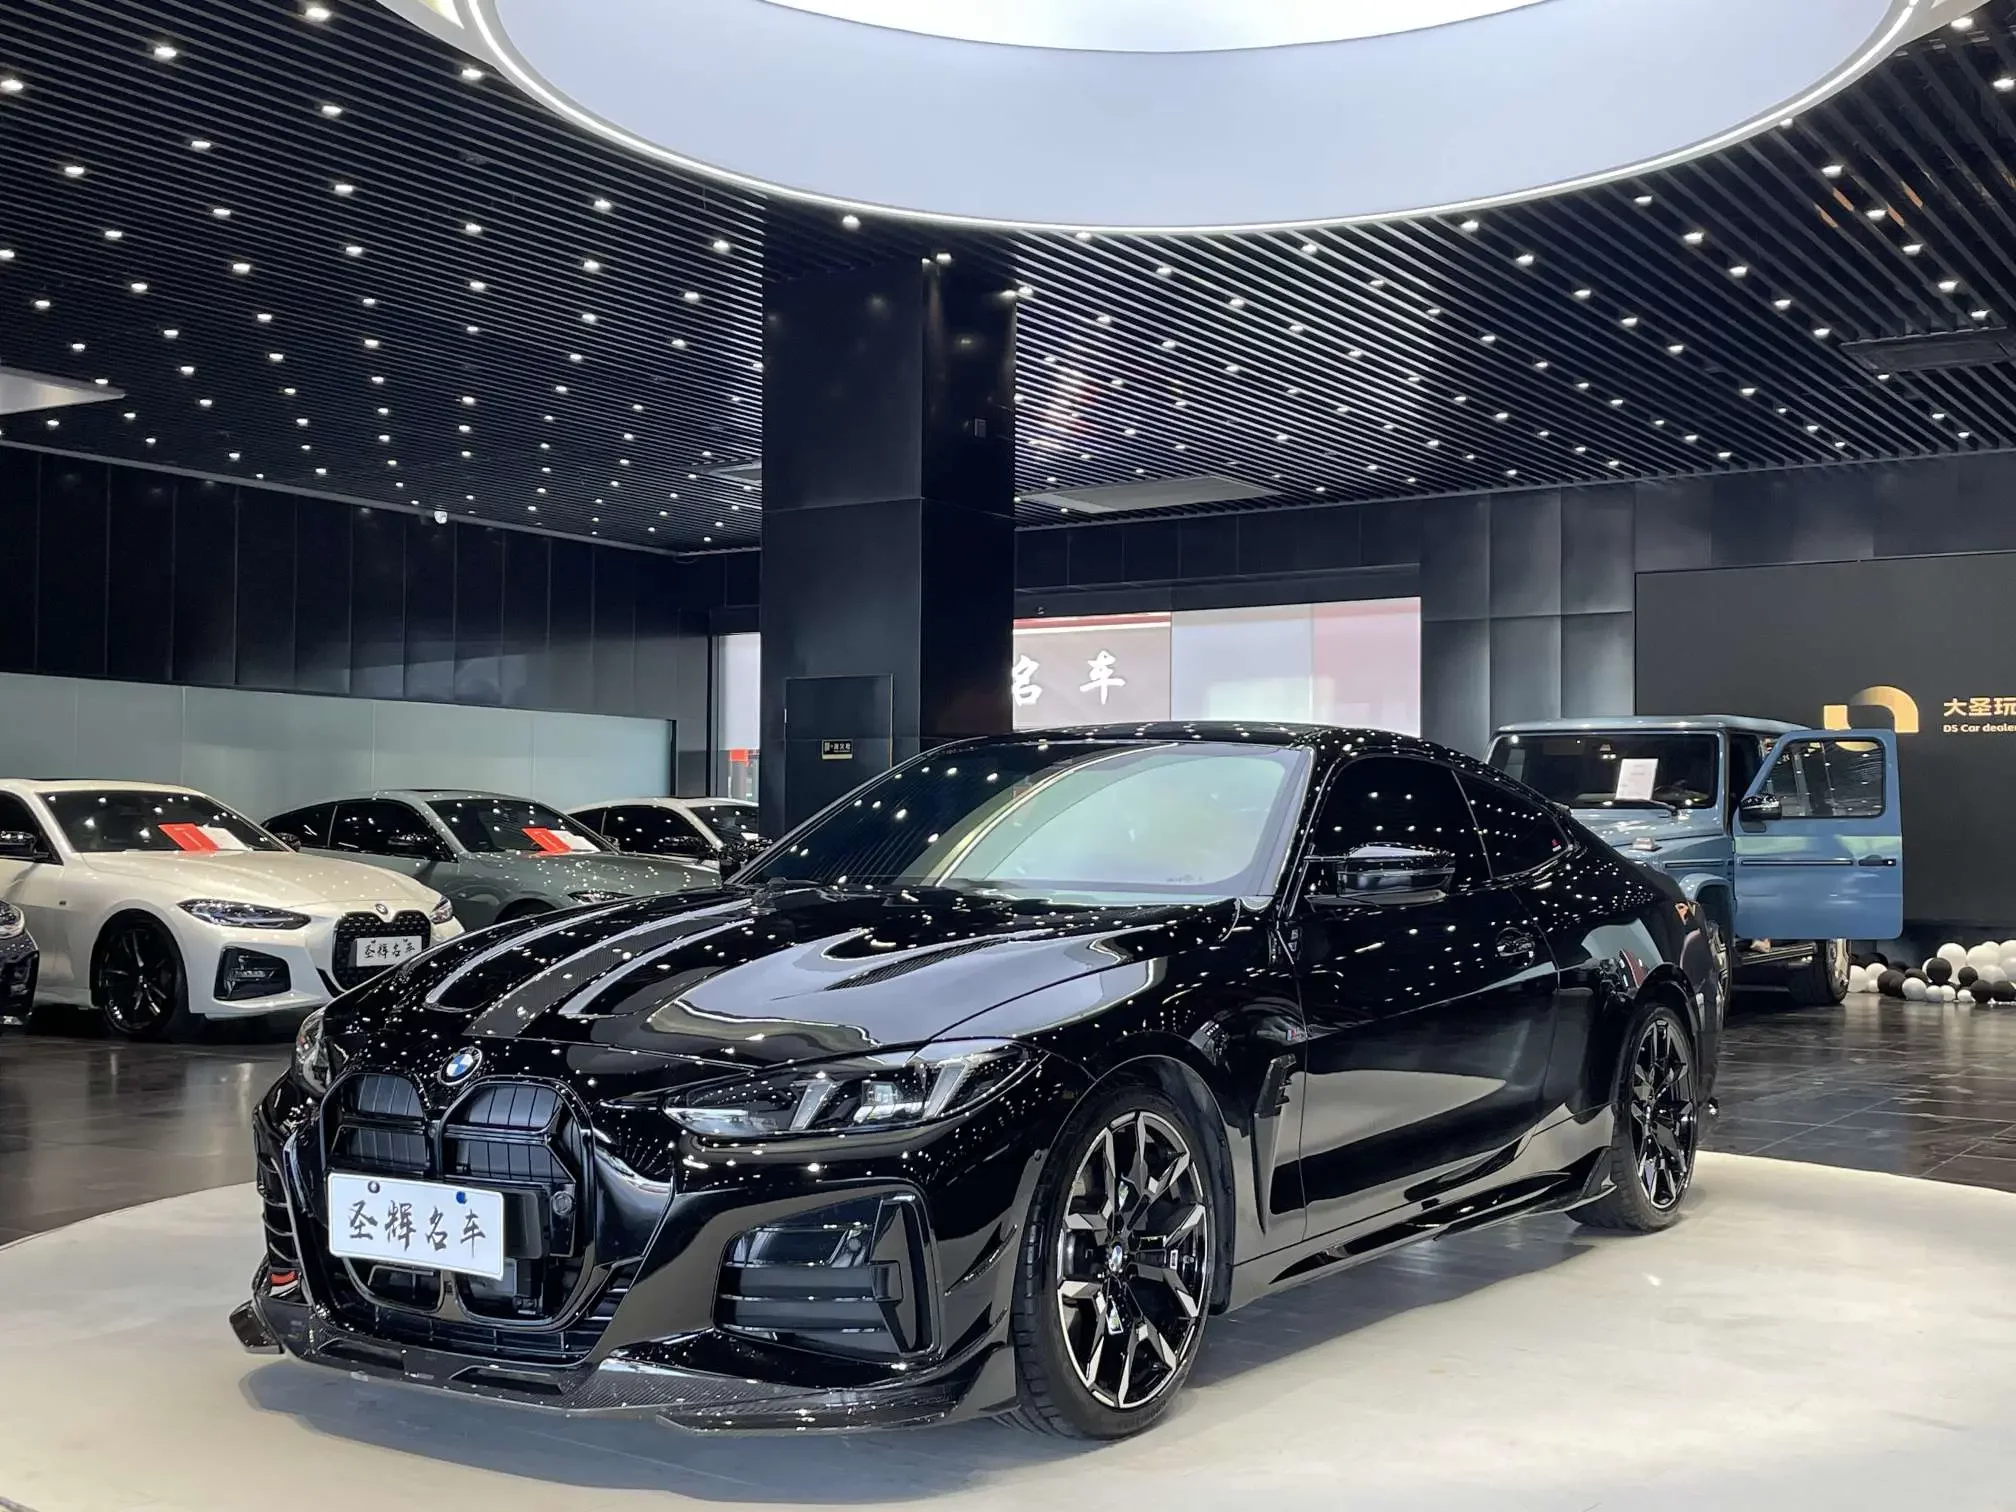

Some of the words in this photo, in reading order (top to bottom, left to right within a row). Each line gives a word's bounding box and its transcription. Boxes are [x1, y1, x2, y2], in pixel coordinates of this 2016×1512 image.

[1012, 650, 1126, 707] 名车
[1943, 697, 2016, 717] 大圣玩
[1943, 724, 1959, 733] DS
[1960, 724, 1981, 733] Car
[348, 1199, 487, 1259] 圣辉名车
